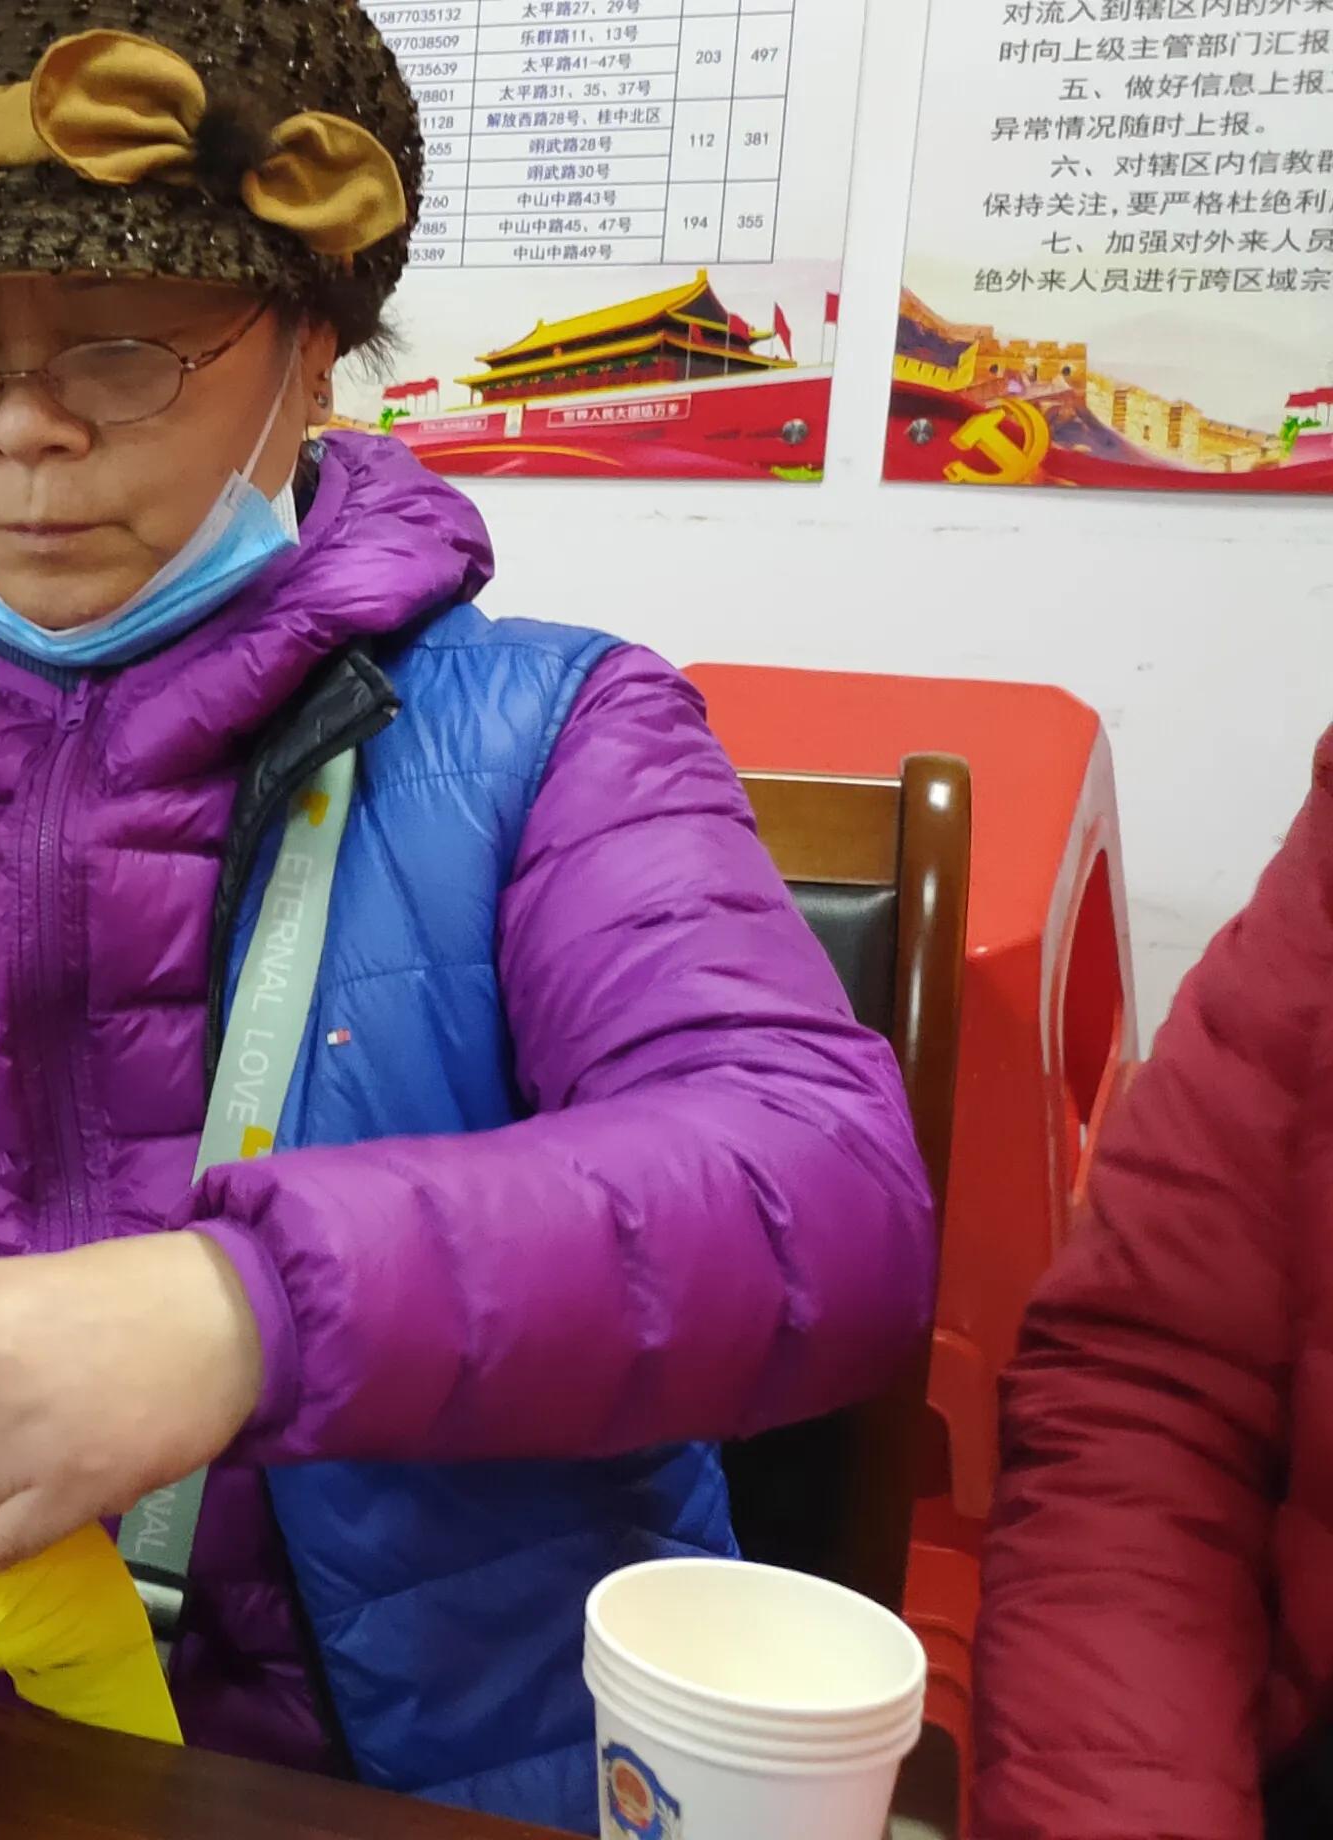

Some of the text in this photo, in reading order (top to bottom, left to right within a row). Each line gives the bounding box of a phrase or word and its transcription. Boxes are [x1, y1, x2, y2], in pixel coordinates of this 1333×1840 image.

[694, 49, 723, 65] 203
[750, 47, 779, 63] 497
[990, 111, 1265, 142] 异常情况随时上报。
[688, 131, 715, 148] 112
[744, 130, 770, 147] 381
[516, 189, 617, 211] 中山中路43号
[682, 214, 708, 231] 194
[737, 213, 764, 230] 355
[513, 243, 613, 263] 中山中路49号
[973, 267, 1331, 294] 绝外来人员进行跨区域宗
[227, 852, 312, 1125] ETERNAL LOVE
